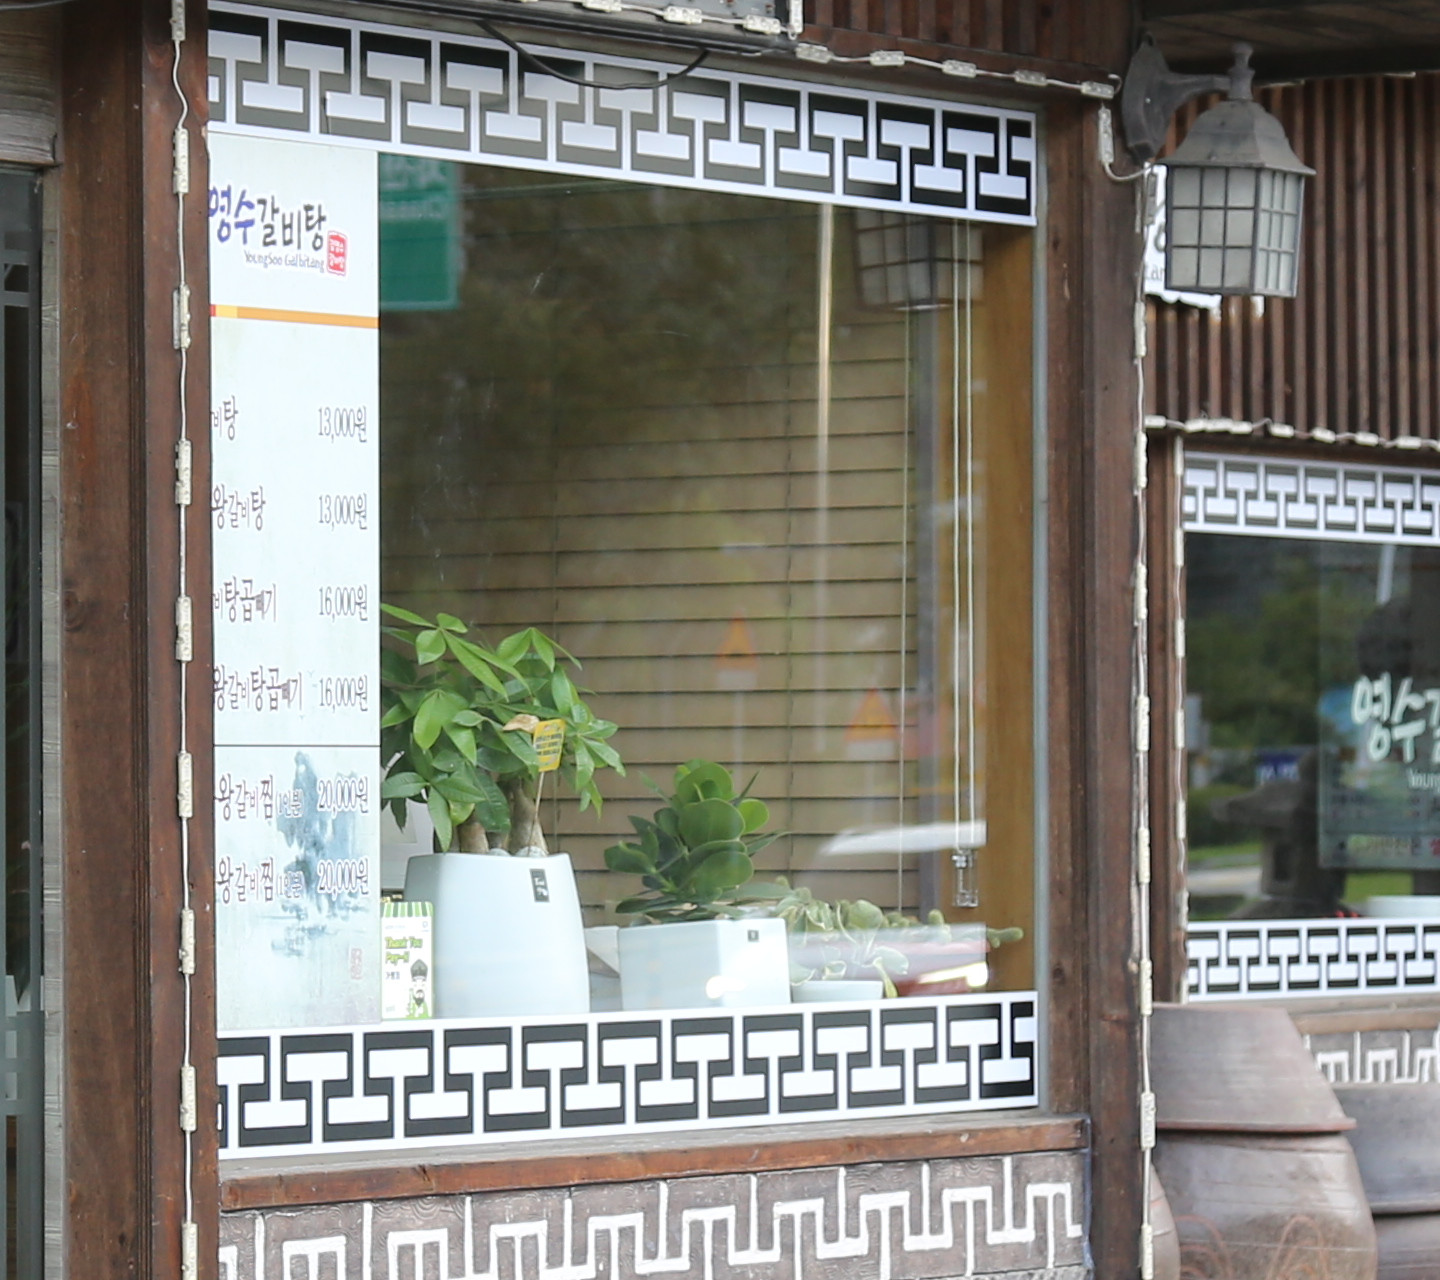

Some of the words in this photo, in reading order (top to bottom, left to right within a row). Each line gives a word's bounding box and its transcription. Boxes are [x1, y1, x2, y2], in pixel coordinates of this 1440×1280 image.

[211, 395, 239, 441] 비탕
[318, 405, 368, 444] 13,000원
[211, 483, 266, 531] 왕갈비탕
[318, 492, 368, 531] 13,000원
[213, 575, 277, 623] 비탕곱빼기
[318, 583, 369, 623] 16,000원
[319, 674, 369, 713] 16,000원
[214, 773, 274, 821] 왕갈비찜
[318, 776, 369, 818] 20,000원
[216, 856, 274, 904] 왕갈비찜
[318, 858, 369, 900] 20,000원
